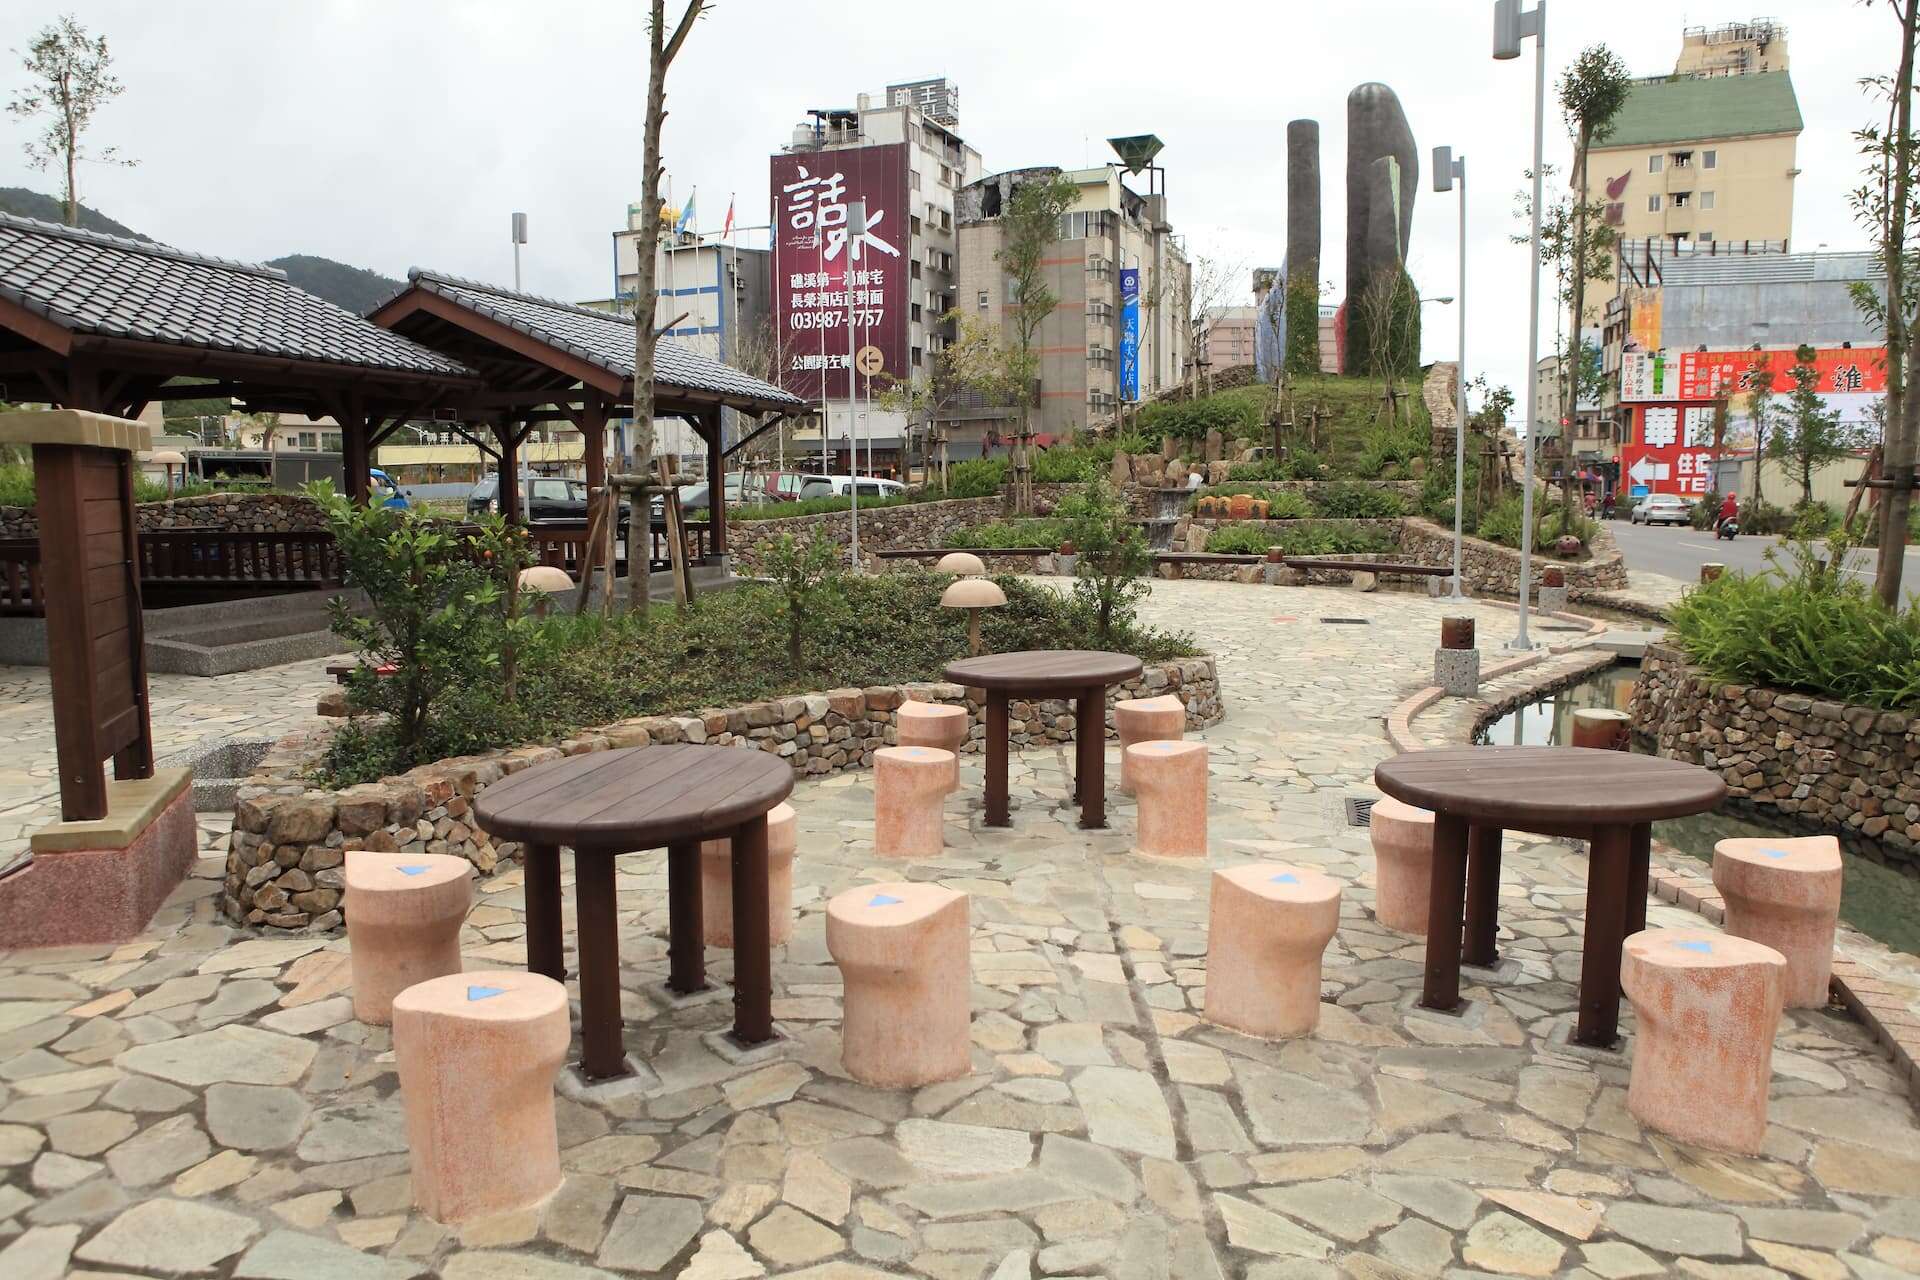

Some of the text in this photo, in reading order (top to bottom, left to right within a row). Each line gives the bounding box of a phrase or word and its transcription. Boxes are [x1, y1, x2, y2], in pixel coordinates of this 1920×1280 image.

[790, 289, 884, 308] 長榮酒店正對面
[791, 354, 852, 370] 公園路左轉
[1676, 477, 1713, 492] TE
